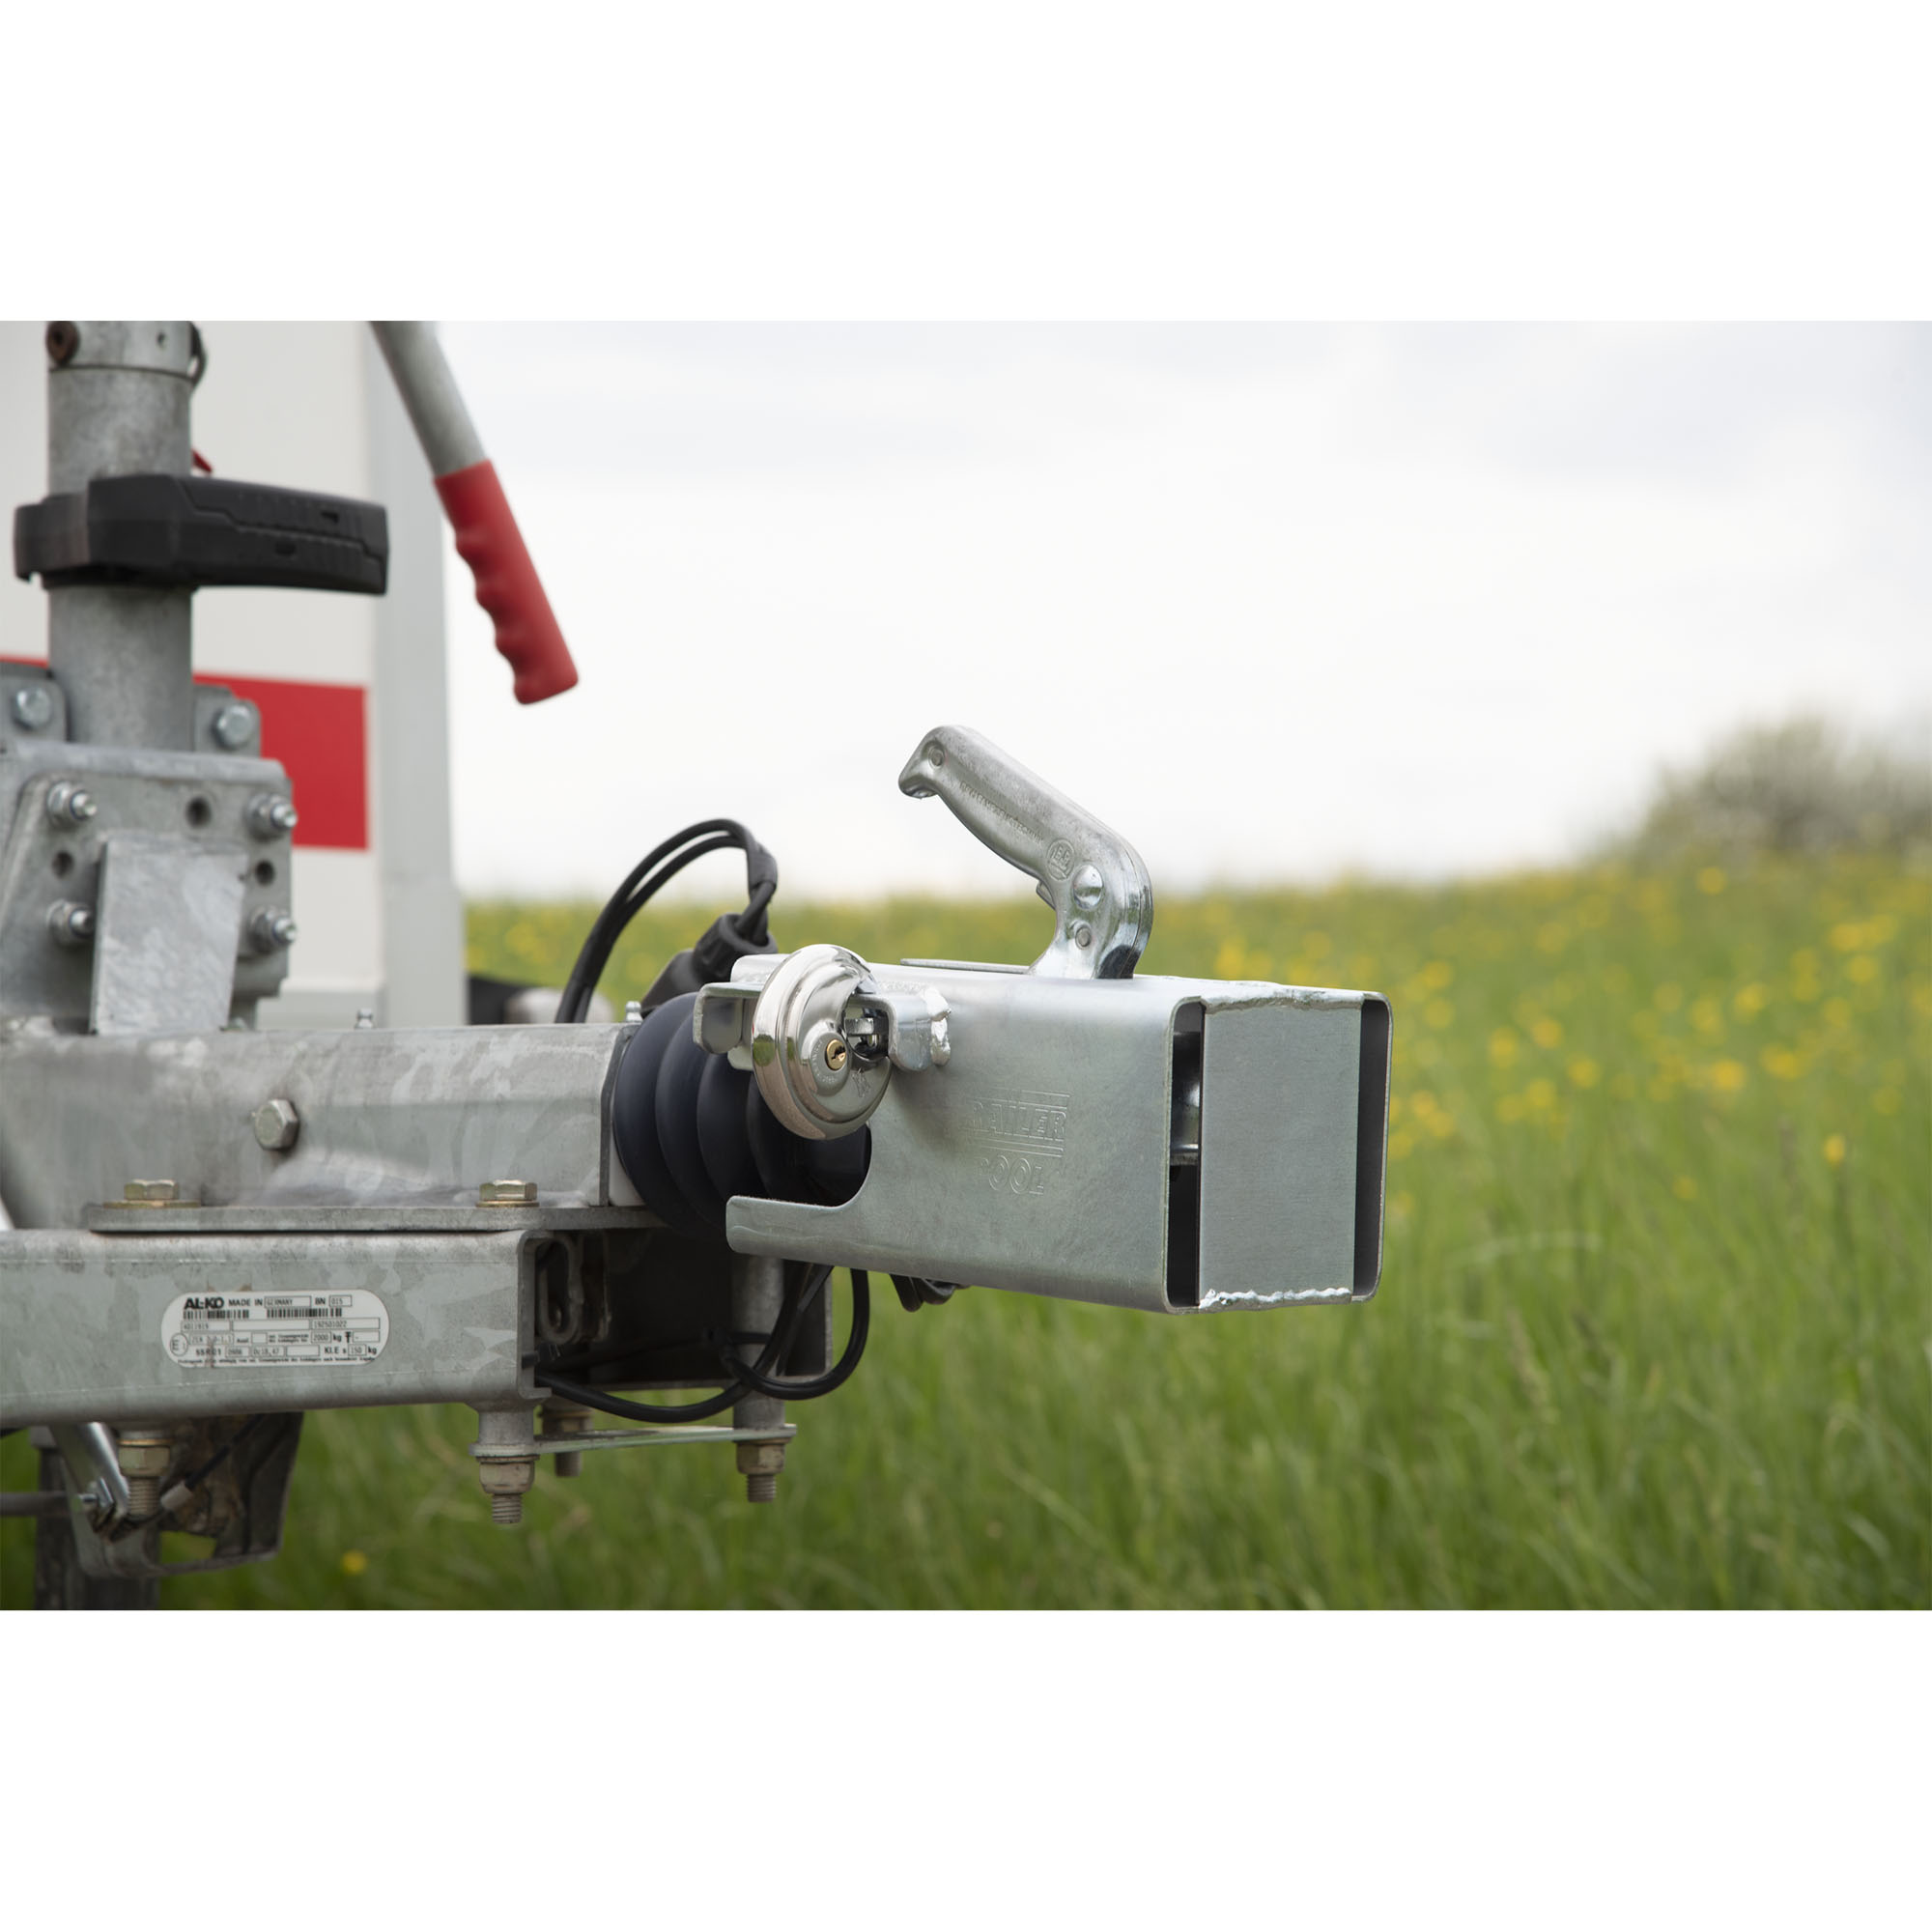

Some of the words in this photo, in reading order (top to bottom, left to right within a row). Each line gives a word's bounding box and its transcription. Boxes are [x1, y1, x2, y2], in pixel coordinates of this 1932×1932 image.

[184, 1296, 224, 1309] AL-KO
[228, 1298, 250, 1307] MADE
[254, 1298, 263, 1307] IN
